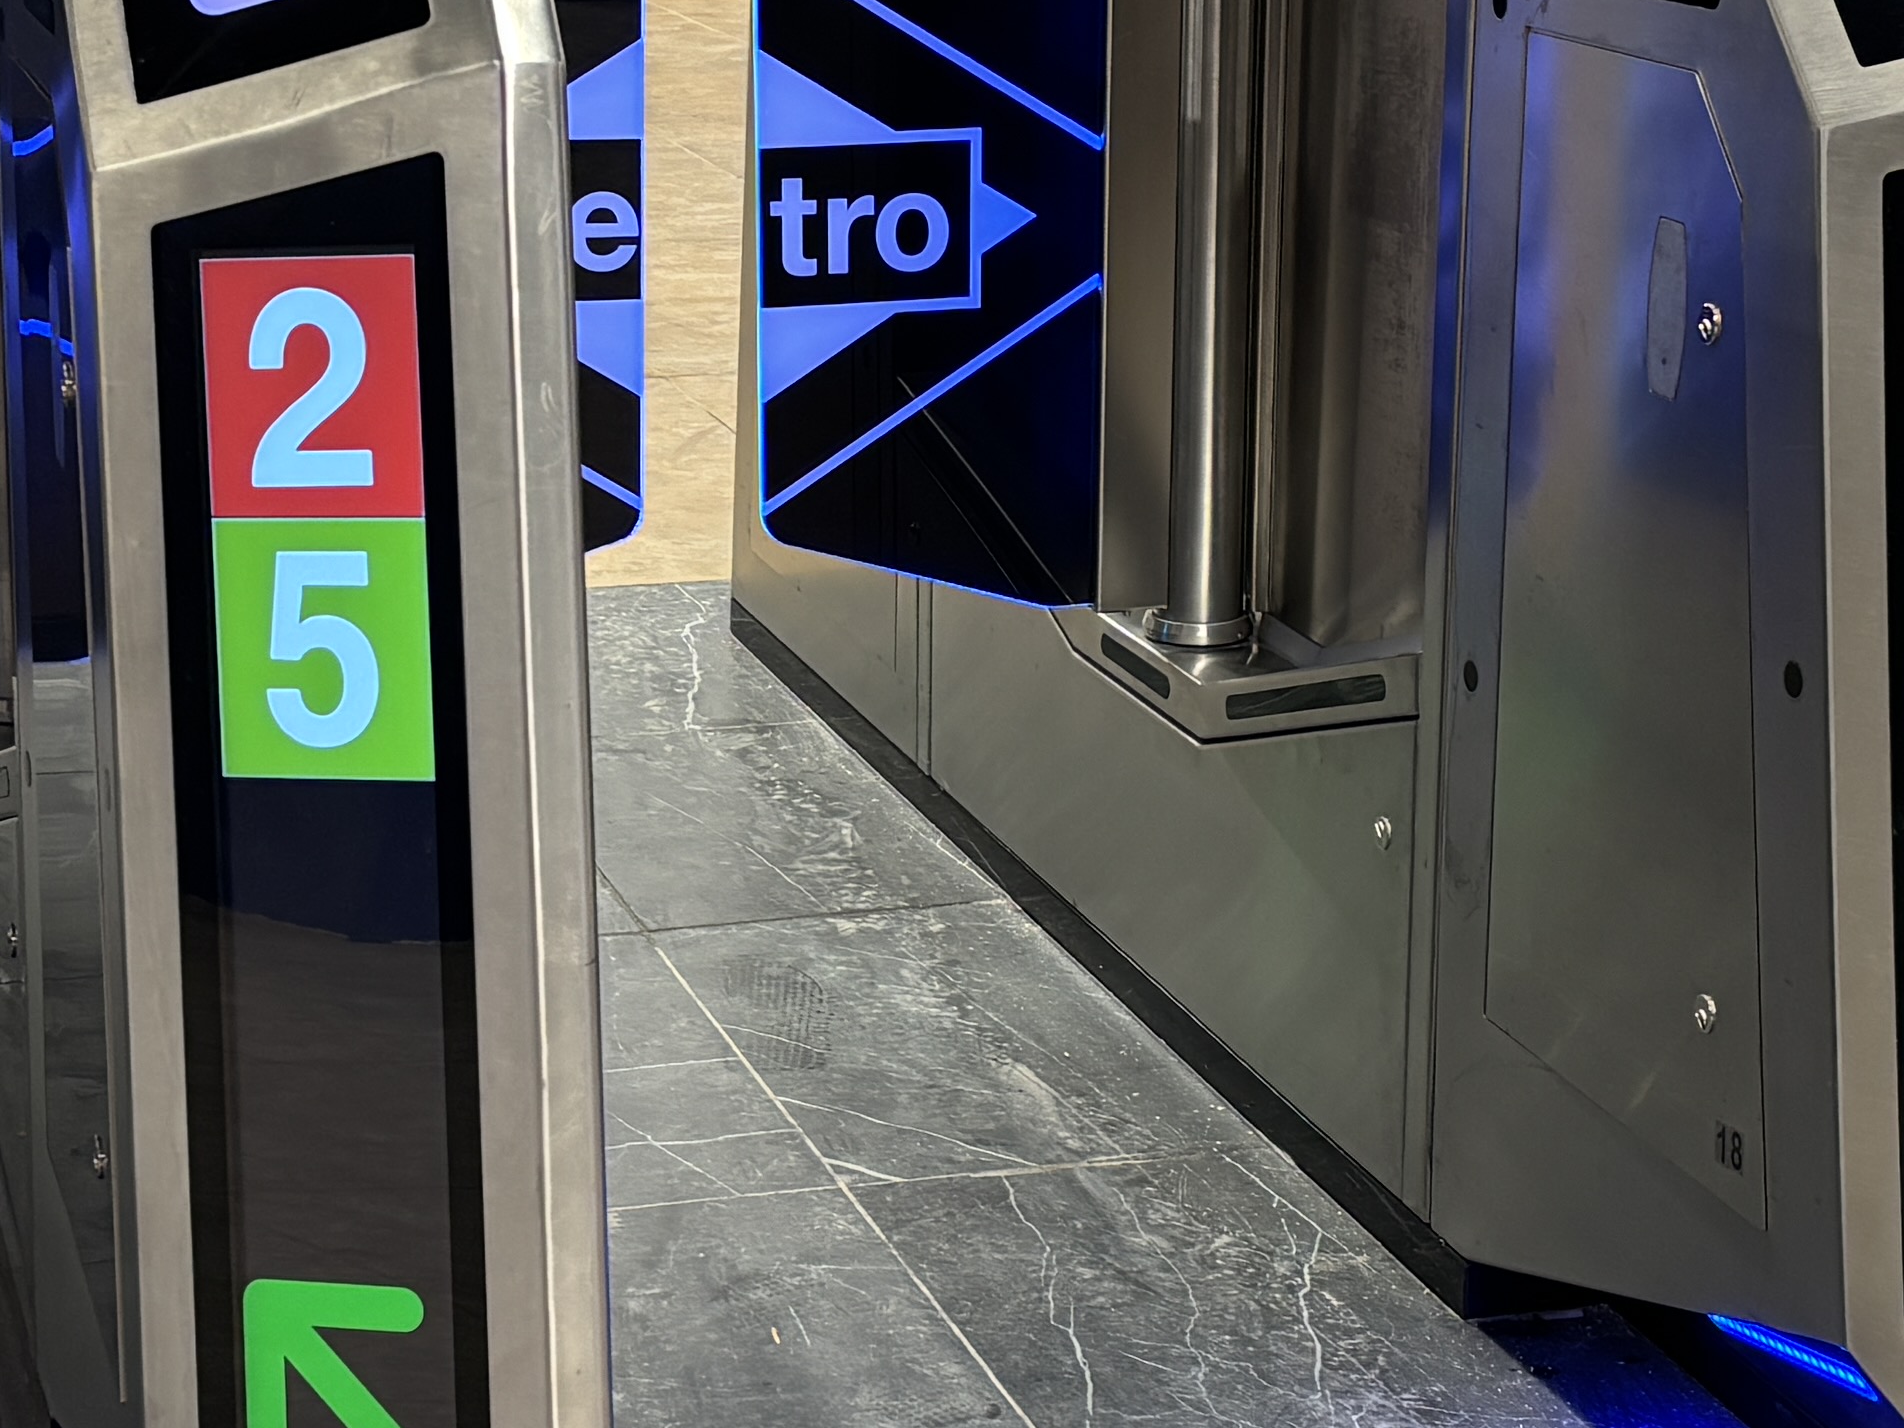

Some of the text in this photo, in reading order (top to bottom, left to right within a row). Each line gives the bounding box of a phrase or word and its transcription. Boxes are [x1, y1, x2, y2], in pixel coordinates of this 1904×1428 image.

[571, 189, 640, 272] e
[248, 286, 375, 488] 2
[266, 550, 380, 749] 5
[1716, 1124, 1742, 1171] 18
